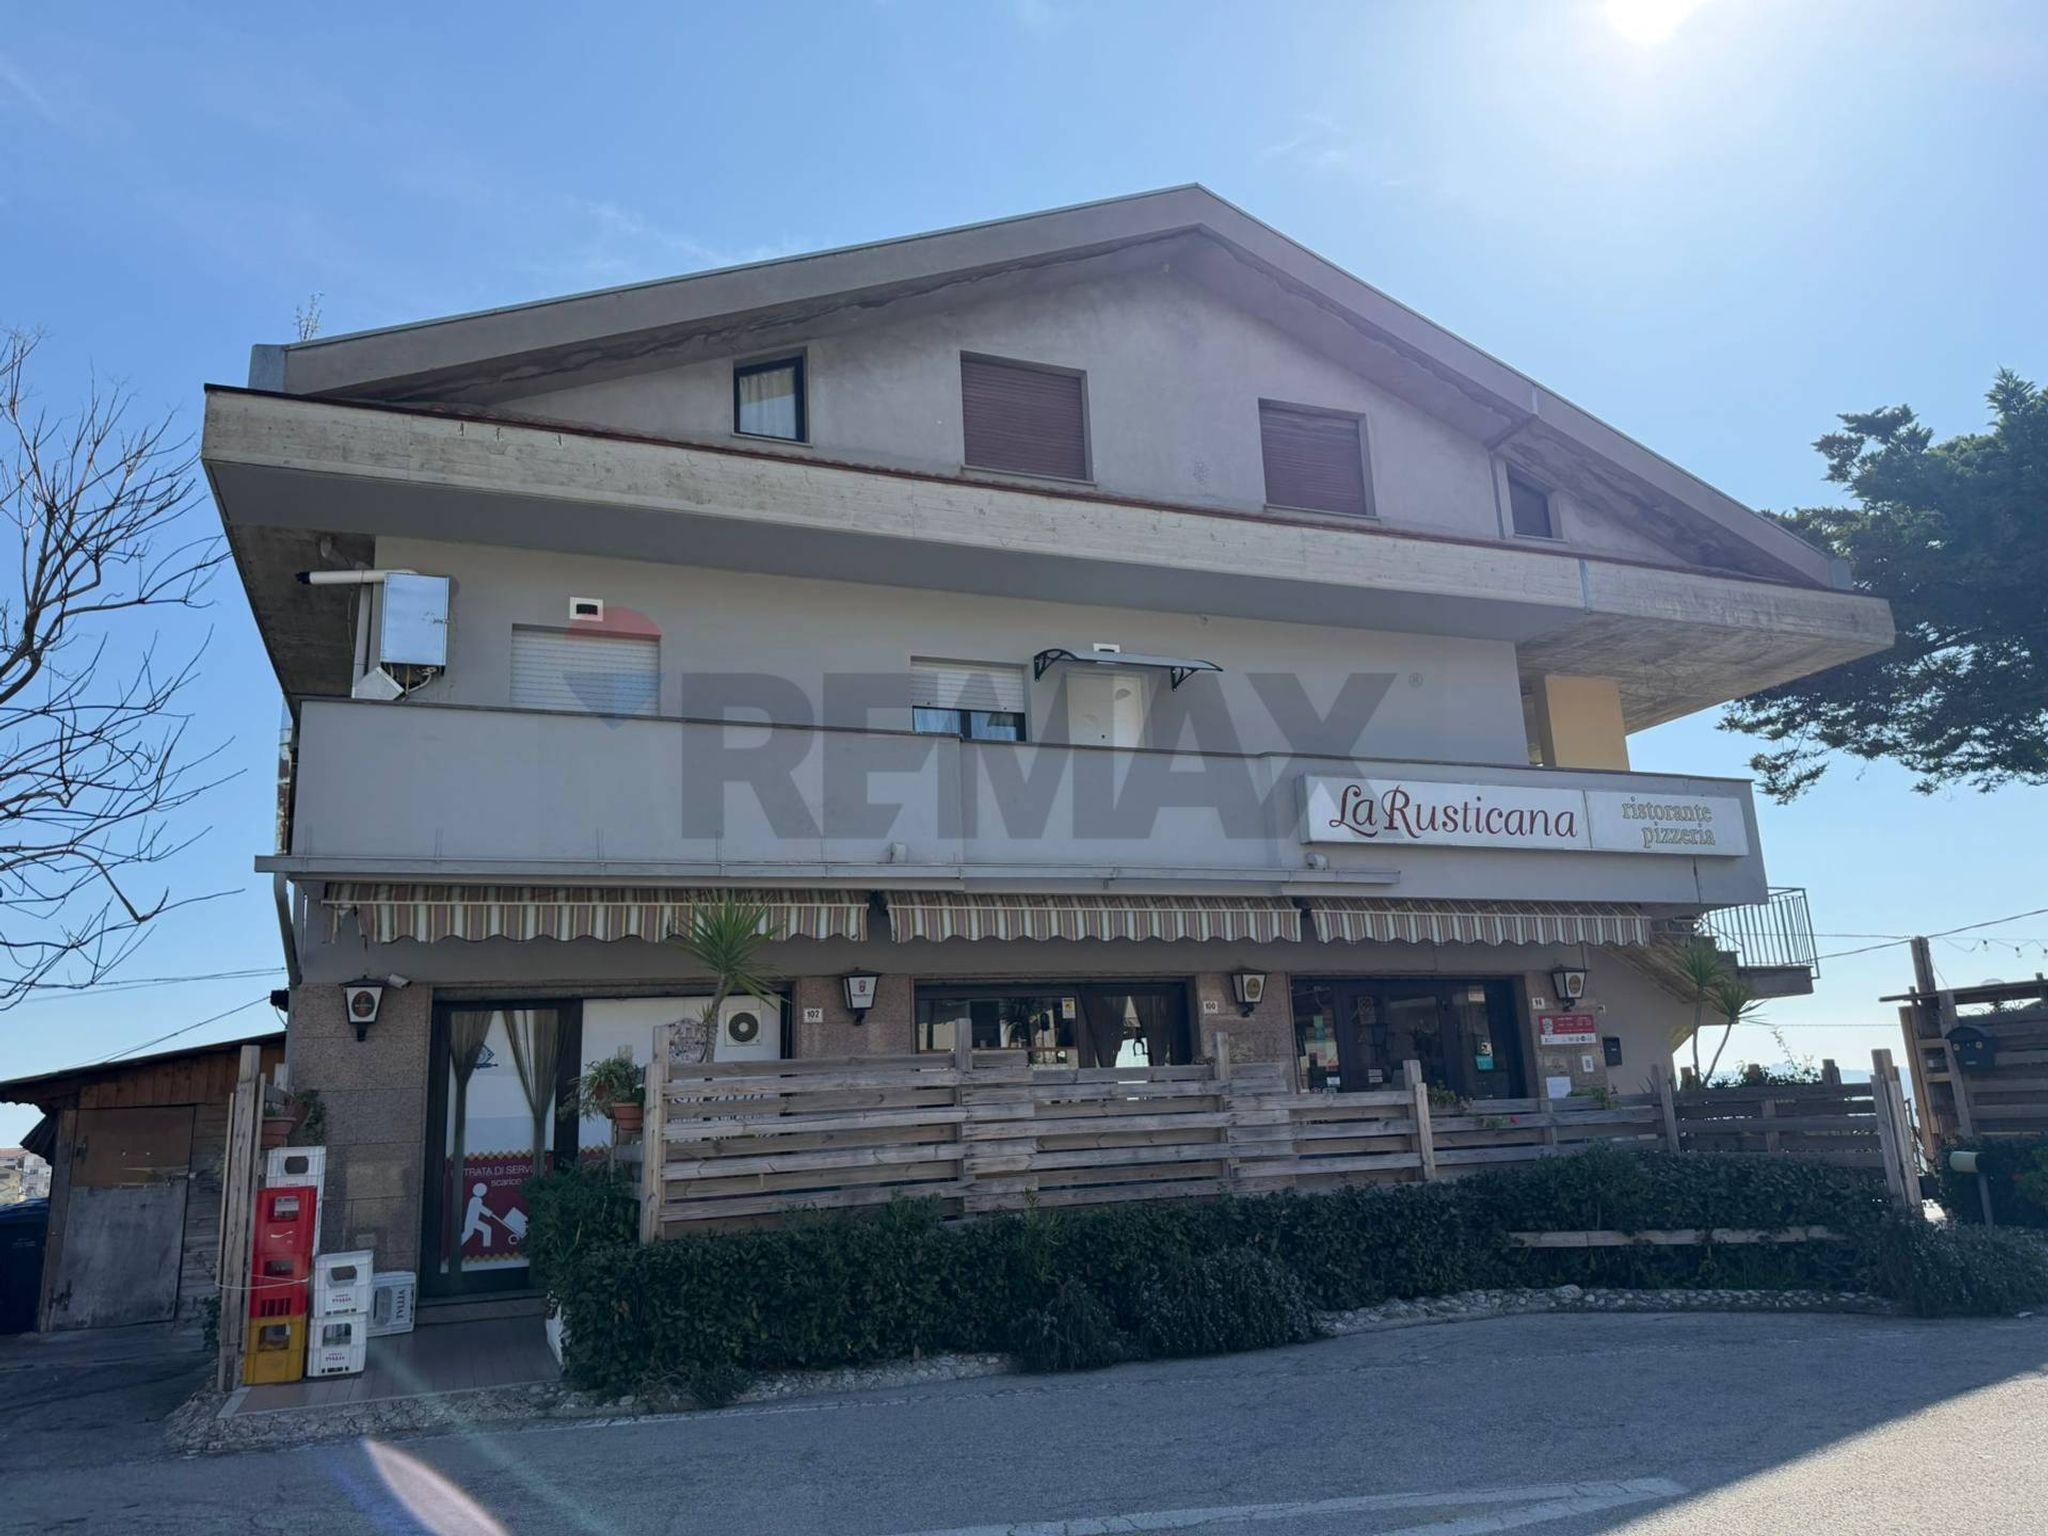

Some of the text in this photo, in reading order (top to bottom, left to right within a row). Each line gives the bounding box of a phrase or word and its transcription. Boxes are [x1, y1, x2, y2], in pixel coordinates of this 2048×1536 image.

[1329, 784, 1578, 839] La Rusticana
[1621, 795, 1713, 823] ristorante
[1641, 820, 1716, 849] pizzeria
[806, 1010, 820, 1019] 102
